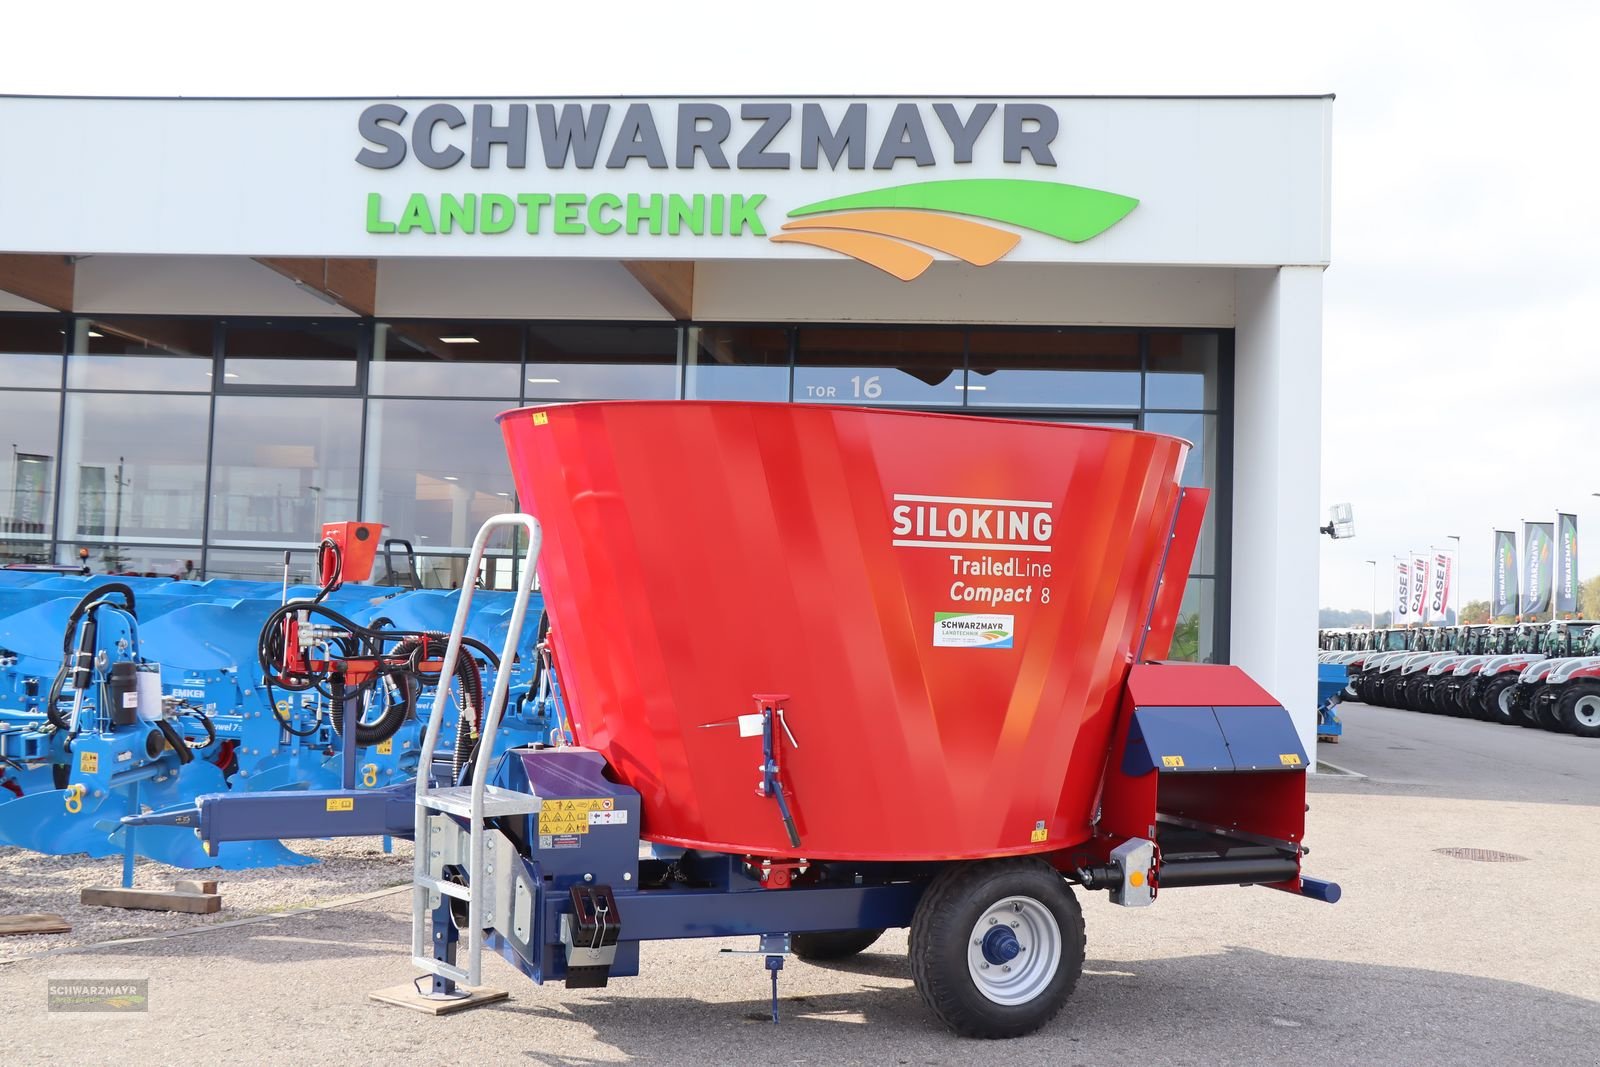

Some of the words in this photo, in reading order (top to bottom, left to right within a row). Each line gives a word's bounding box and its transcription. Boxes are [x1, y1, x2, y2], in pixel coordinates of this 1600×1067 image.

[354, 103, 1060, 171] SCHWARZMAYR
[366, 192, 767, 236] LANDTECHNIK
[806, 385, 837, 398] TOR
[850, 375, 883, 399] 16
[892, 505, 1053, 542] SILOKING
[949, 555, 1052, 578] TrailedLine
[1530, 540, 1539, 602] SCHWARZMAYR
[950, 581, 1033, 607] Compact
[1040, 587, 1051, 604] 8
[1399, 576, 1408, 615] CASE
[1412, 572, 1424, 612] CASE
[1432, 569, 1445, 611] CASE
[941, 620, 1004, 630] SCHWARZMAYR
